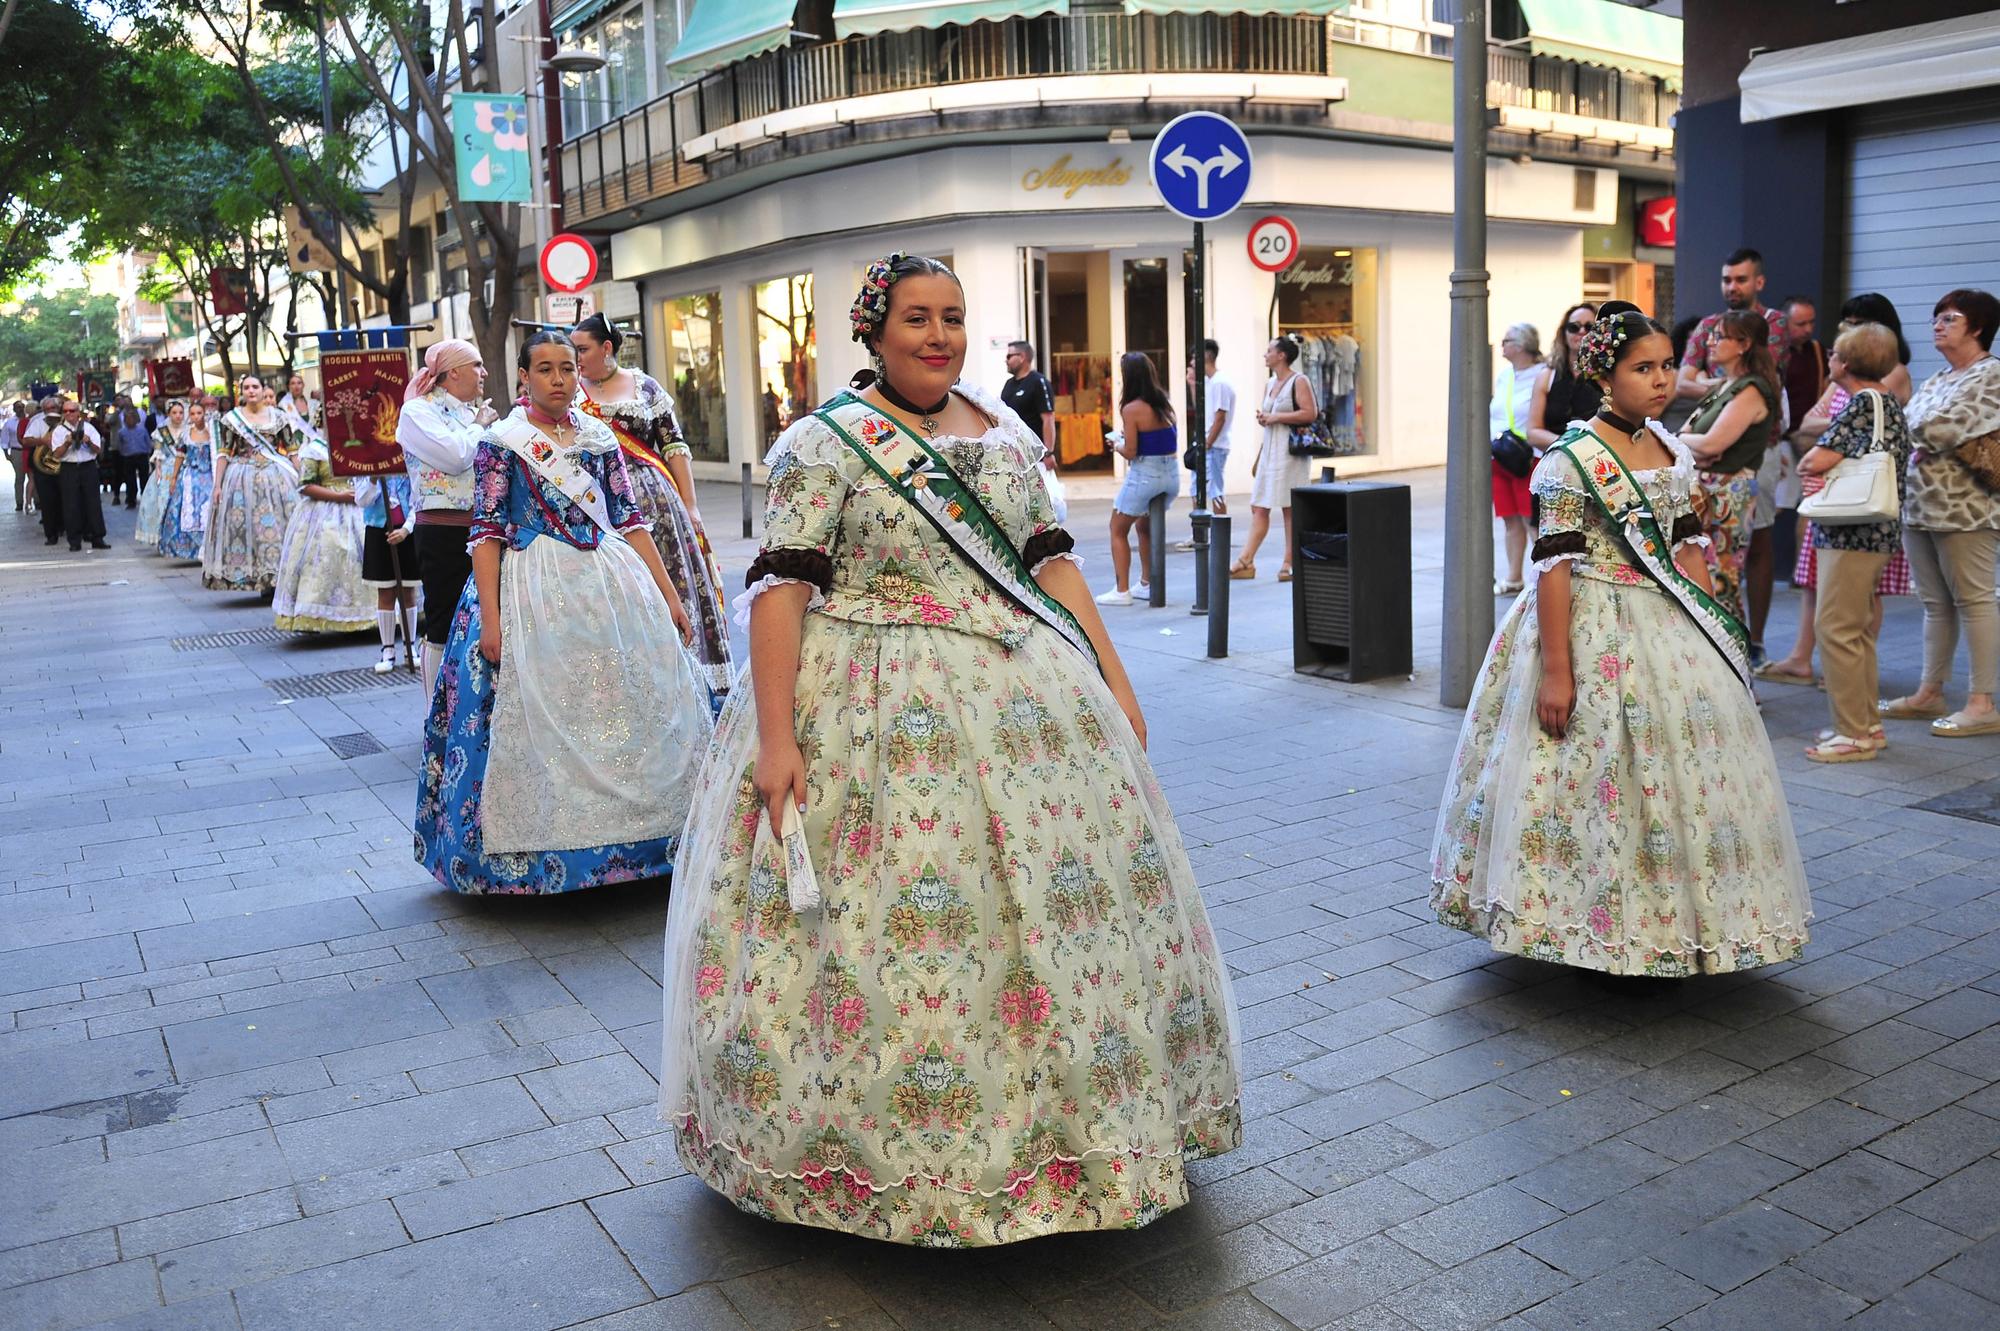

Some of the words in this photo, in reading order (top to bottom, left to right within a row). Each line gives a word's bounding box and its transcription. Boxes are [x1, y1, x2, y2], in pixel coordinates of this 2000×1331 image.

[1259, 236, 1286, 253] 20
[325, 356, 361, 365] HOGUERA
[368, 354, 402, 362] INFANTIL
[328, 370, 358, 387] CARRER
[374, 369, 403, 385] MAJOR
[332, 450, 345, 463] SAN
[348, 460, 374, 471] VICENTE
[378, 460, 391, 469] DEL
[968, 521, 1017, 584] DAMA
[1023, 581, 1046, 604] DE
[1658, 559, 1698, 606] DAMA
[1705, 606, 1728, 626] DE
